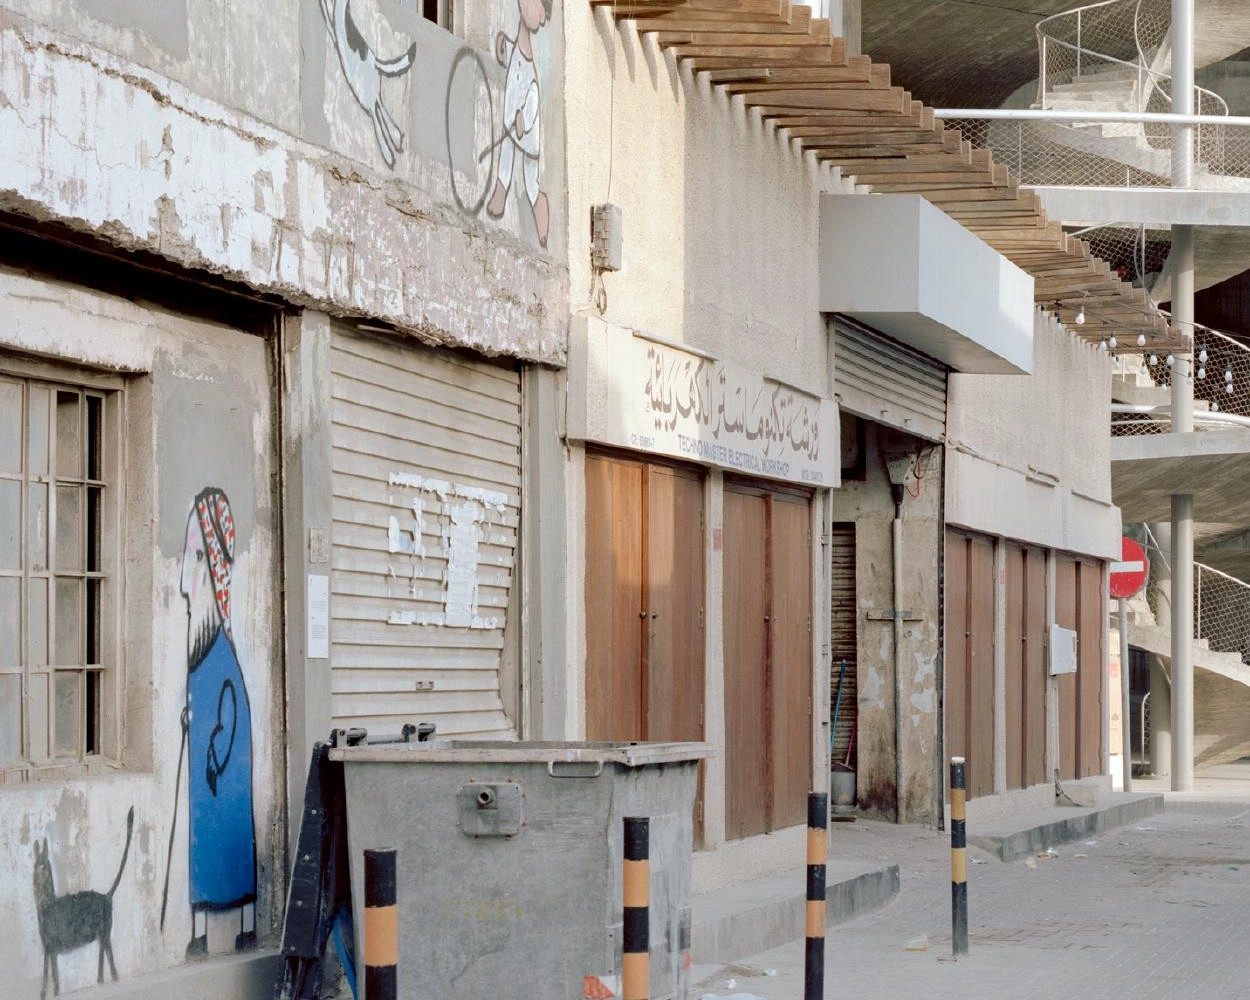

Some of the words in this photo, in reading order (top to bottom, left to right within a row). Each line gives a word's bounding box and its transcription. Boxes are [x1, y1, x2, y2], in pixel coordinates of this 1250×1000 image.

[678, 434, 703, 456] TECHNO
[704, 441, 727, 462] MASTER
[728, 447, 761, 473] ELECTRICAL
[762, 457, 790, 476] WORKSHOP
